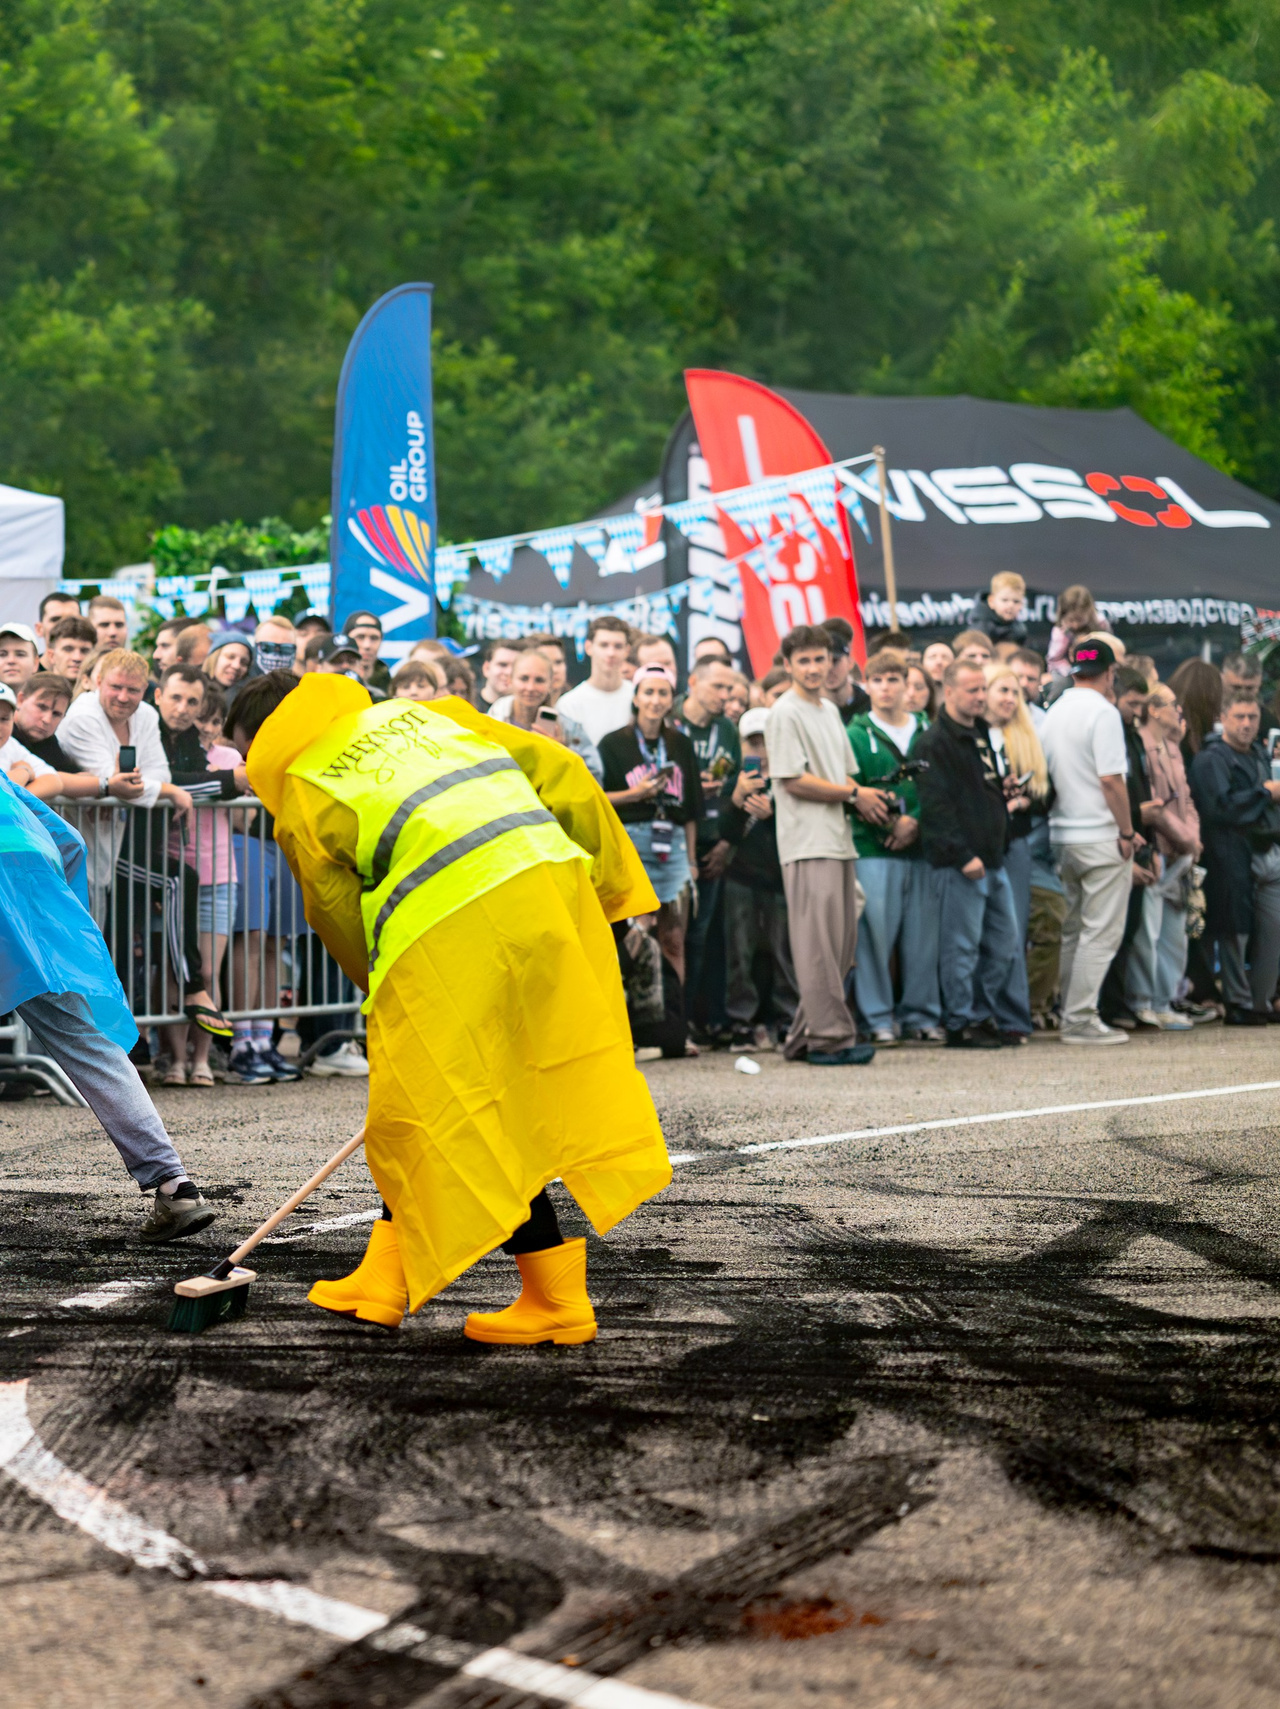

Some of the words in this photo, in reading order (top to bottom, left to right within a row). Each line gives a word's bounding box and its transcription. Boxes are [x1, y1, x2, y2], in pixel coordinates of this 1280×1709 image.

[389, 458, 408, 502] OIL
[408, 411, 427, 503] GROUP
[834, 463, 1270, 529] VISSOL
